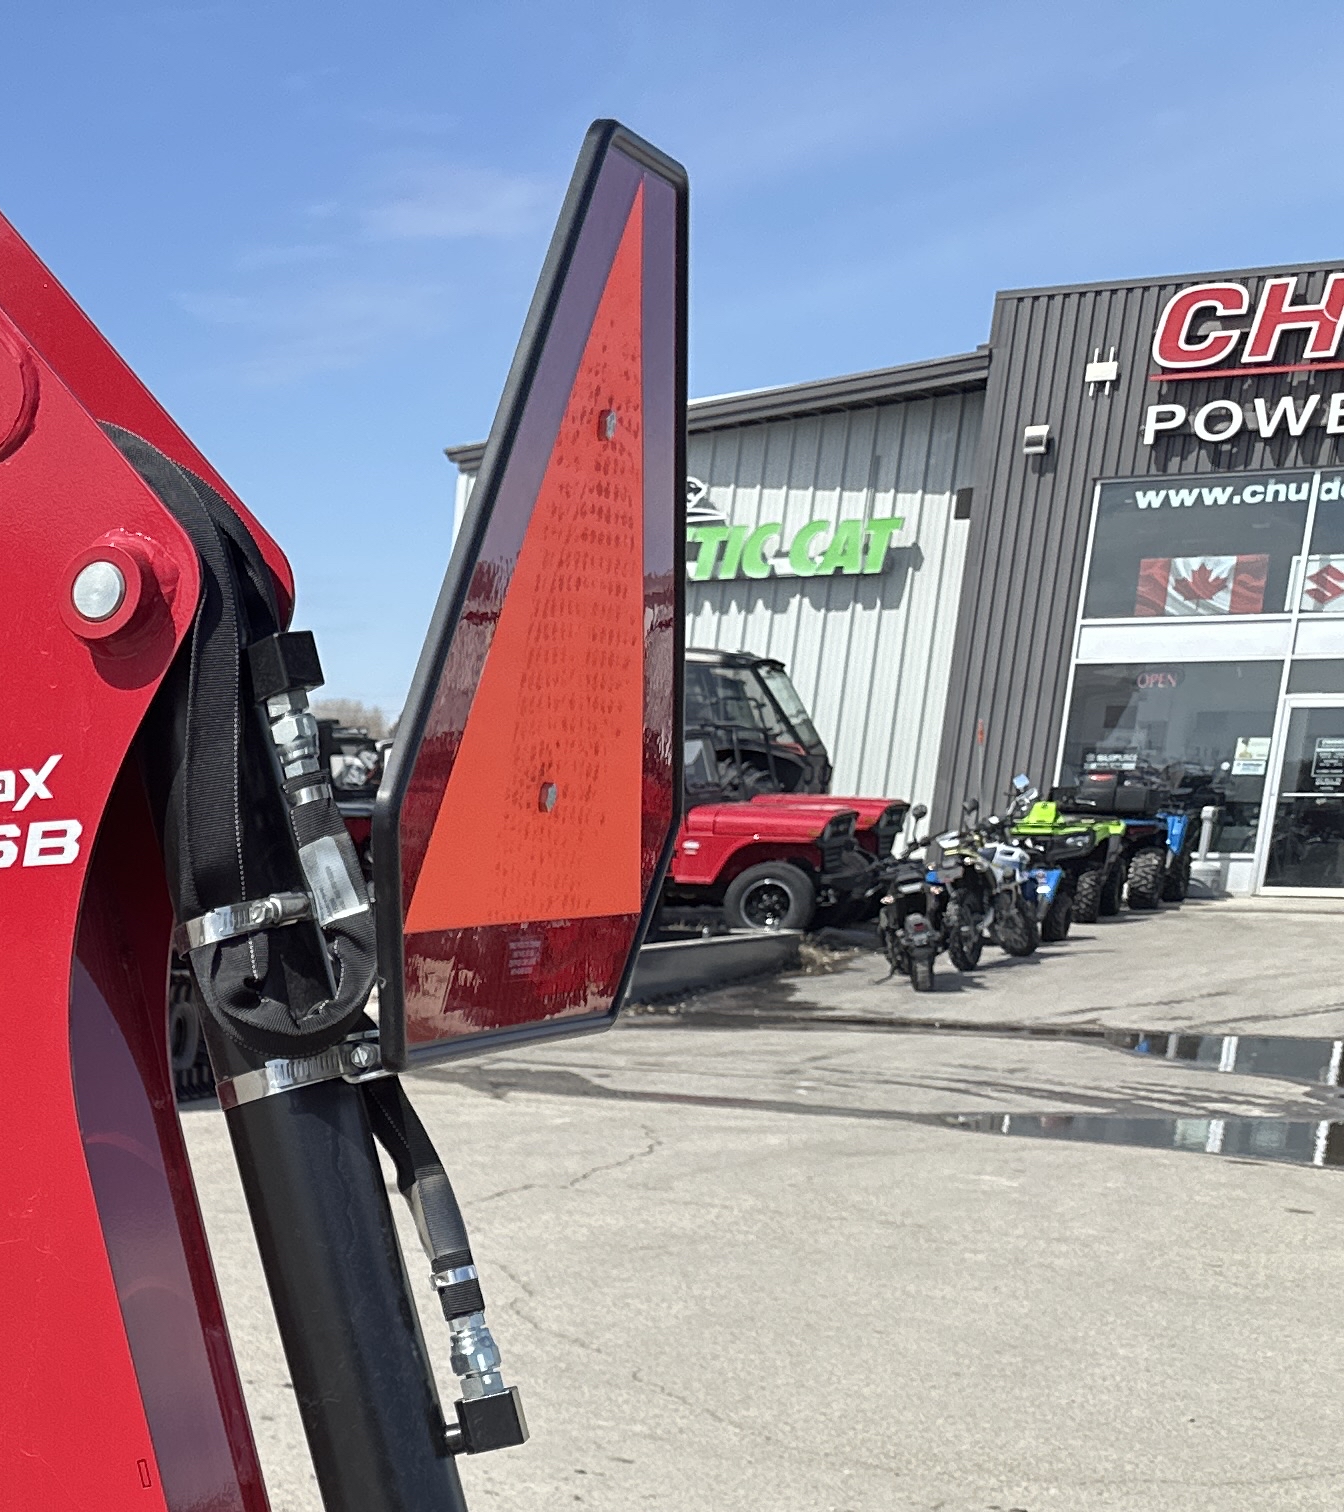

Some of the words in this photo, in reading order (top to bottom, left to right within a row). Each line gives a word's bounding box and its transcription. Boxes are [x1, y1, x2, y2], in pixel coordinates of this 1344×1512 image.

[686, 521, 782, 581] TIC
[789, 517, 905, 577] CAT
[1135, 672, 1178, 690] OPEN
